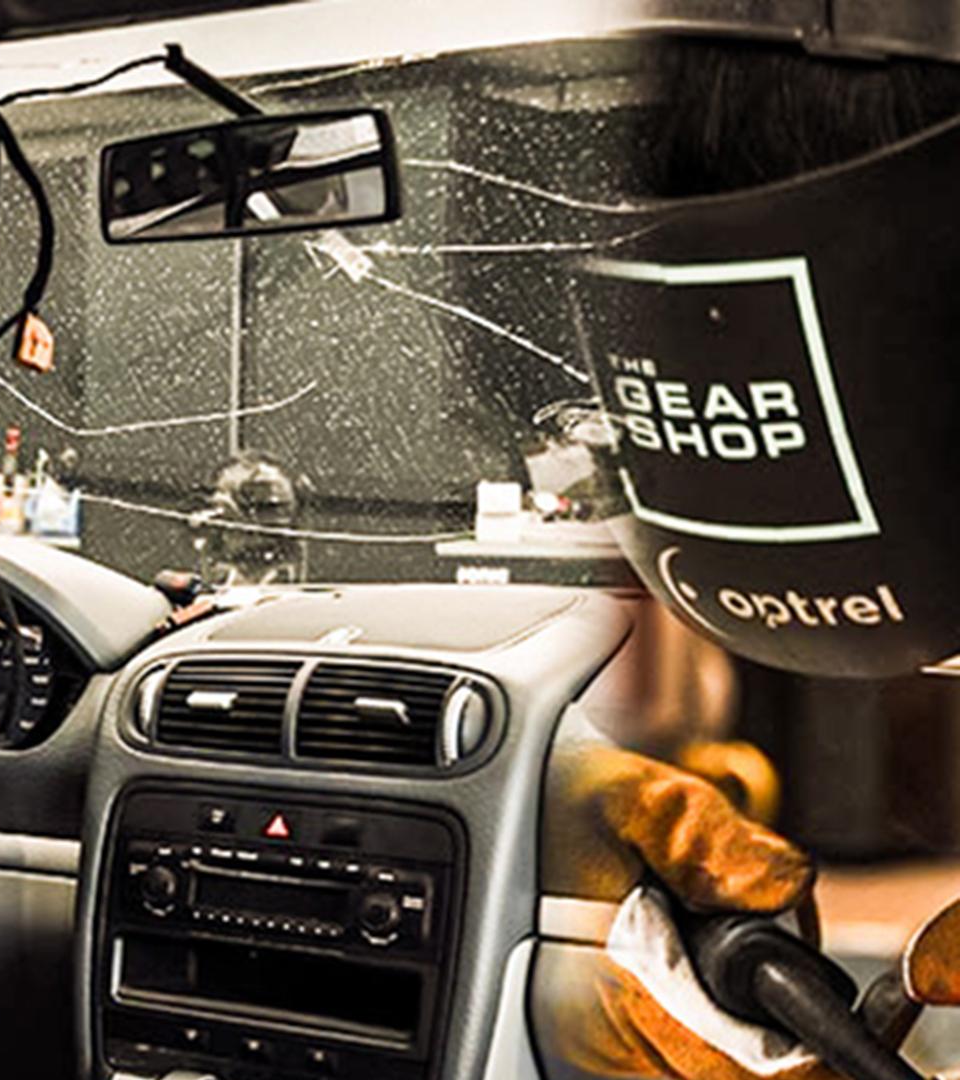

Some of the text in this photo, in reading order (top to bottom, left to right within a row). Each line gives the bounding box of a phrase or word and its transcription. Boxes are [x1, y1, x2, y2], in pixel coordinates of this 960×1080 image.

[608, 354, 657, 377] THE
[615, 376, 800, 419] GEAR
[624, 414, 806, 459] SHOP
[718, 585, 904, 629] optrel
